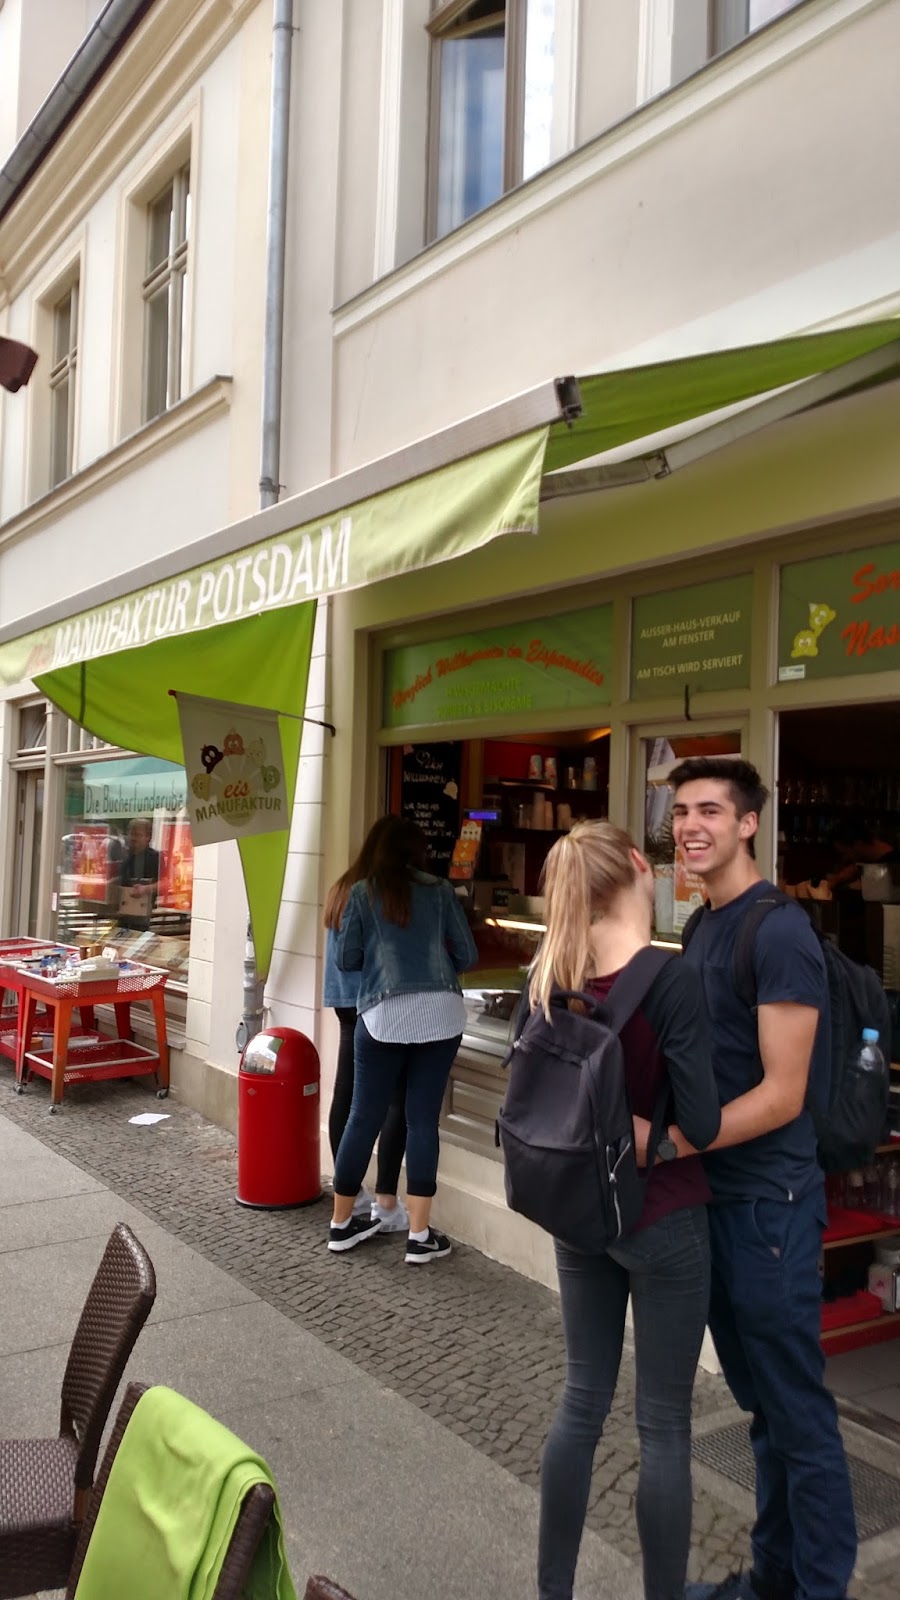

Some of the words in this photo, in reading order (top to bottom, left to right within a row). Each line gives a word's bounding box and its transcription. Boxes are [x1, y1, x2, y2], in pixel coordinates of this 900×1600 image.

[51, 579, 191, 667] MANUFAKTUR
[194, 516, 352, 625] POTSDAM
[640, 611, 741, 639] AUSSER-HAUS-VERKAUF
[662, 638, 677, 648] AM
[679, 630, 715, 645] FENSTER
[526, 639, 604, 686] Eisparadies
[637, 669, 650, 679] AM
[653, 665, 676, 678] TISCH
[677, 661, 700, 673] WIRD
[702, 654, 743, 671] SERVIERT
[223, 780, 250, 798] eis
[195, 796, 282, 823] MANUFAKTUR
